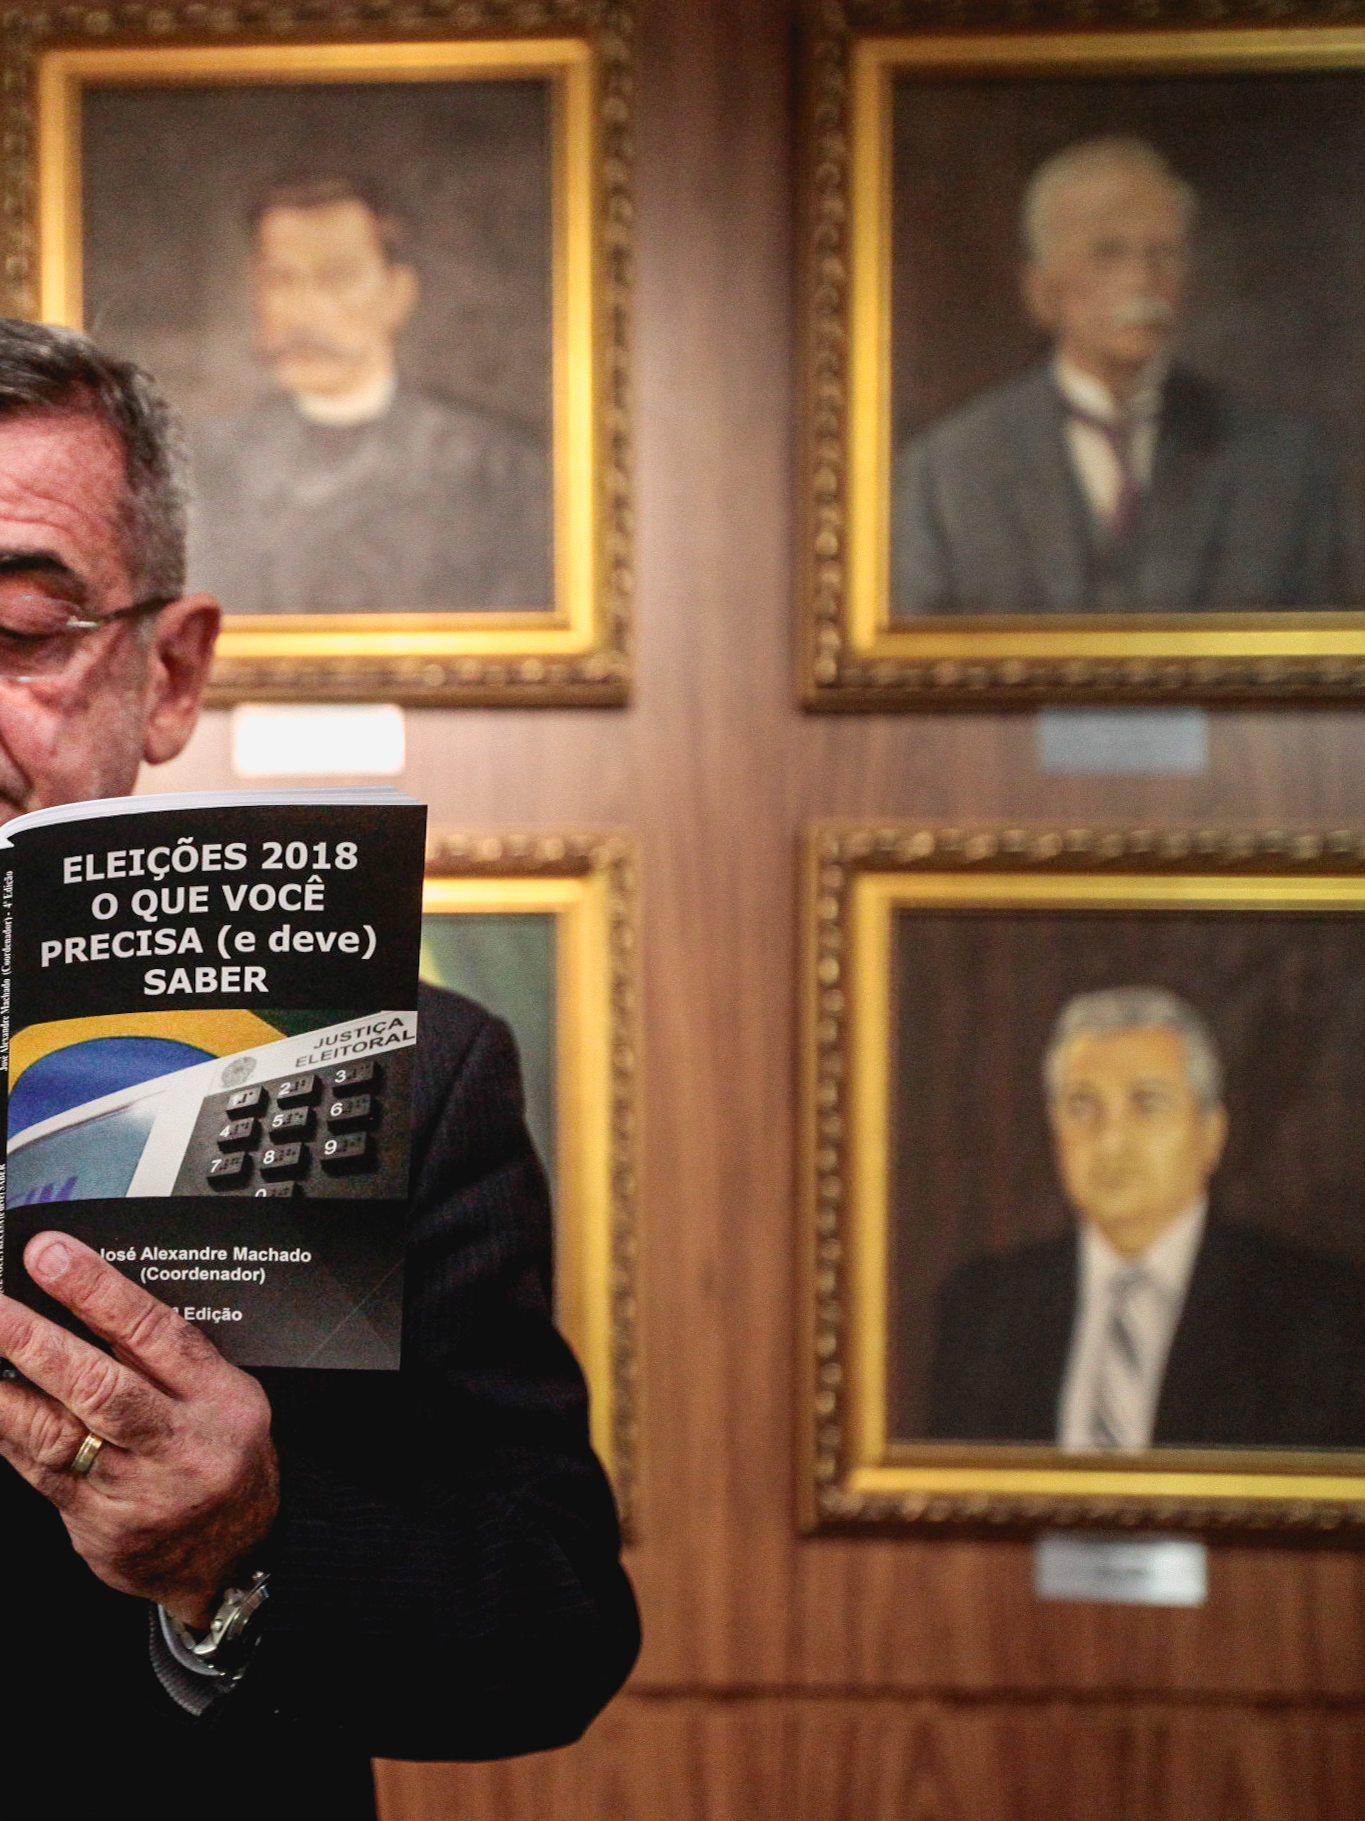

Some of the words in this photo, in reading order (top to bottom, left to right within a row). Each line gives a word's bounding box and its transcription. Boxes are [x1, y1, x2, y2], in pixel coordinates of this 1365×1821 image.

[63, 837, 247, 884] ELEIÇÕES
[262, 841, 358, 871] 2018
[91, 893, 119, 920] O
[131, 886, 210, 921] QUE
[222, 874, 325, 912] VOCÊ
[1, 916, 13, 974] (Coordenador)
[41, 927, 203, 967] PRECISA
[217, 925, 256, 959] (e
[268, 925, 377, 958] deve)
[0, 977, 11, 1012] Machado
[143, 965, 268, 996] SABER
[0, 1014, 11, 1052] Alexandre
[295, 1030, 416, 1068] ELEITORAL
[313, 1018, 404, 1049] JUSTIÇA
[0, 1054, 10, 1070] José
[279, 1082, 291, 1096] 2
[335, 1070, 347, 1083] 3
[219, 1125, 230, 1137] 4
[272, 1114, 284, 1127] 5
[330, 1102, 343, 1116] 6
[211, 1159, 222, 1173] 7
[263, 1150, 275, 1164] 8
[324, 1139, 337, 1155] 9
[141, 1246, 228, 1262] Alexandre
[233, 1246, 312, 1263] Machado
[140, 1266, 266, 1285] (Coordenador)
[184, 1306, 243, 1324] Edição
